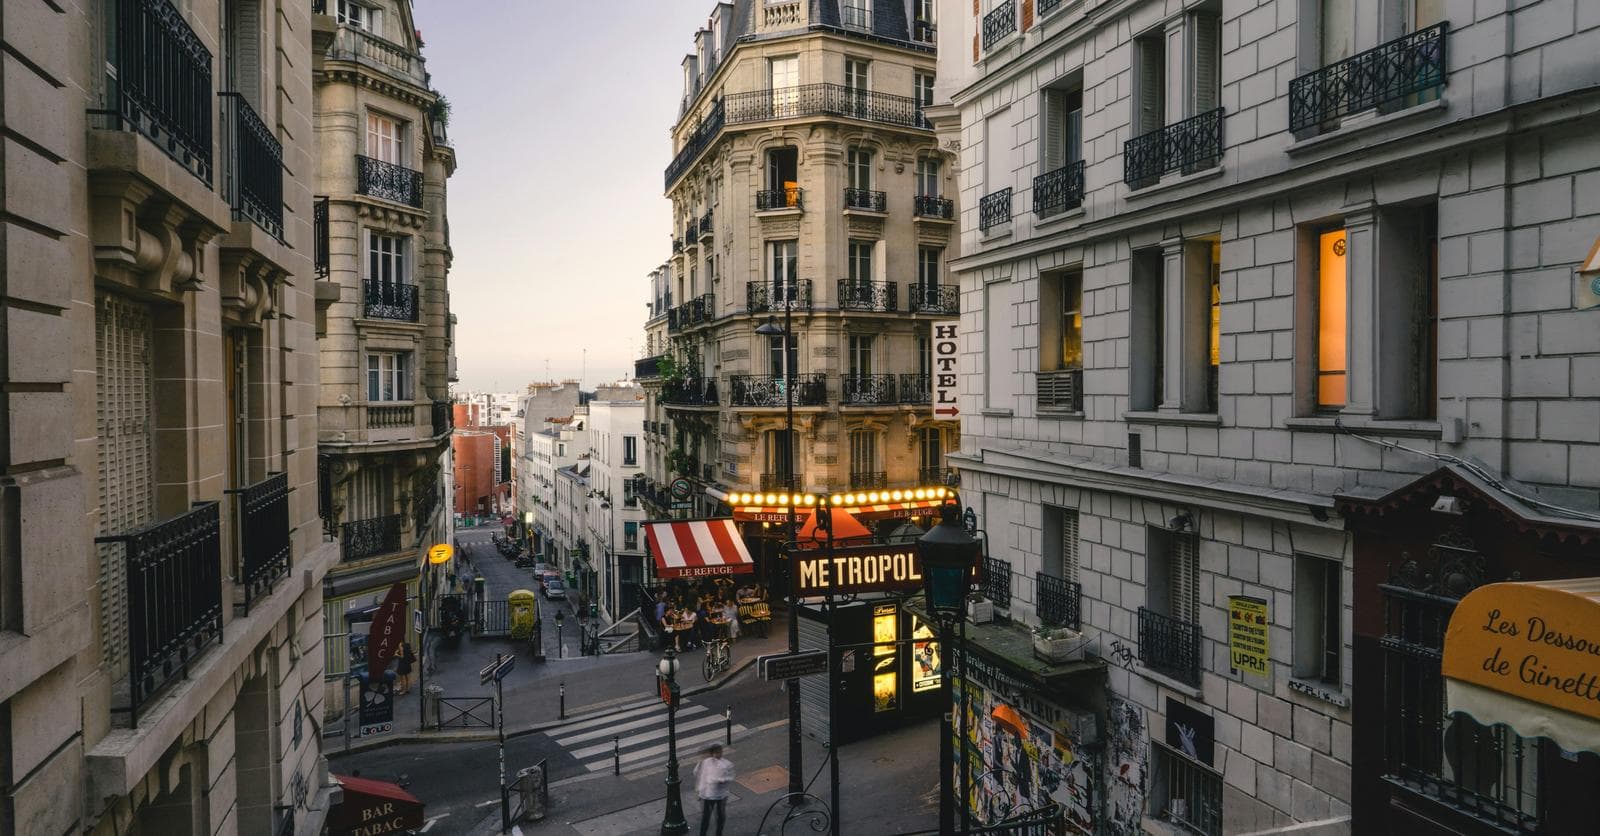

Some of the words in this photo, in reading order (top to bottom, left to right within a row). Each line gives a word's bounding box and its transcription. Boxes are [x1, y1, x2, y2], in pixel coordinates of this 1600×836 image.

[935, 325, 958, 405] HOTEL
[754, 513, 766, 522] LE
[768, 513, 803, 523] REFUE
[679, 568, 692, 577] LE
[694, 565, 733, 576] REFUGE
[799, 553, 976, 589] METROPOL
[377, 602, 400, 659] TABAC
[1482, 608, 1520, 637] Les
[1482, 647, 1511, 677] de
[351, 816, 403, 836] TABAC
[361, 801, 394, 822] BAR
